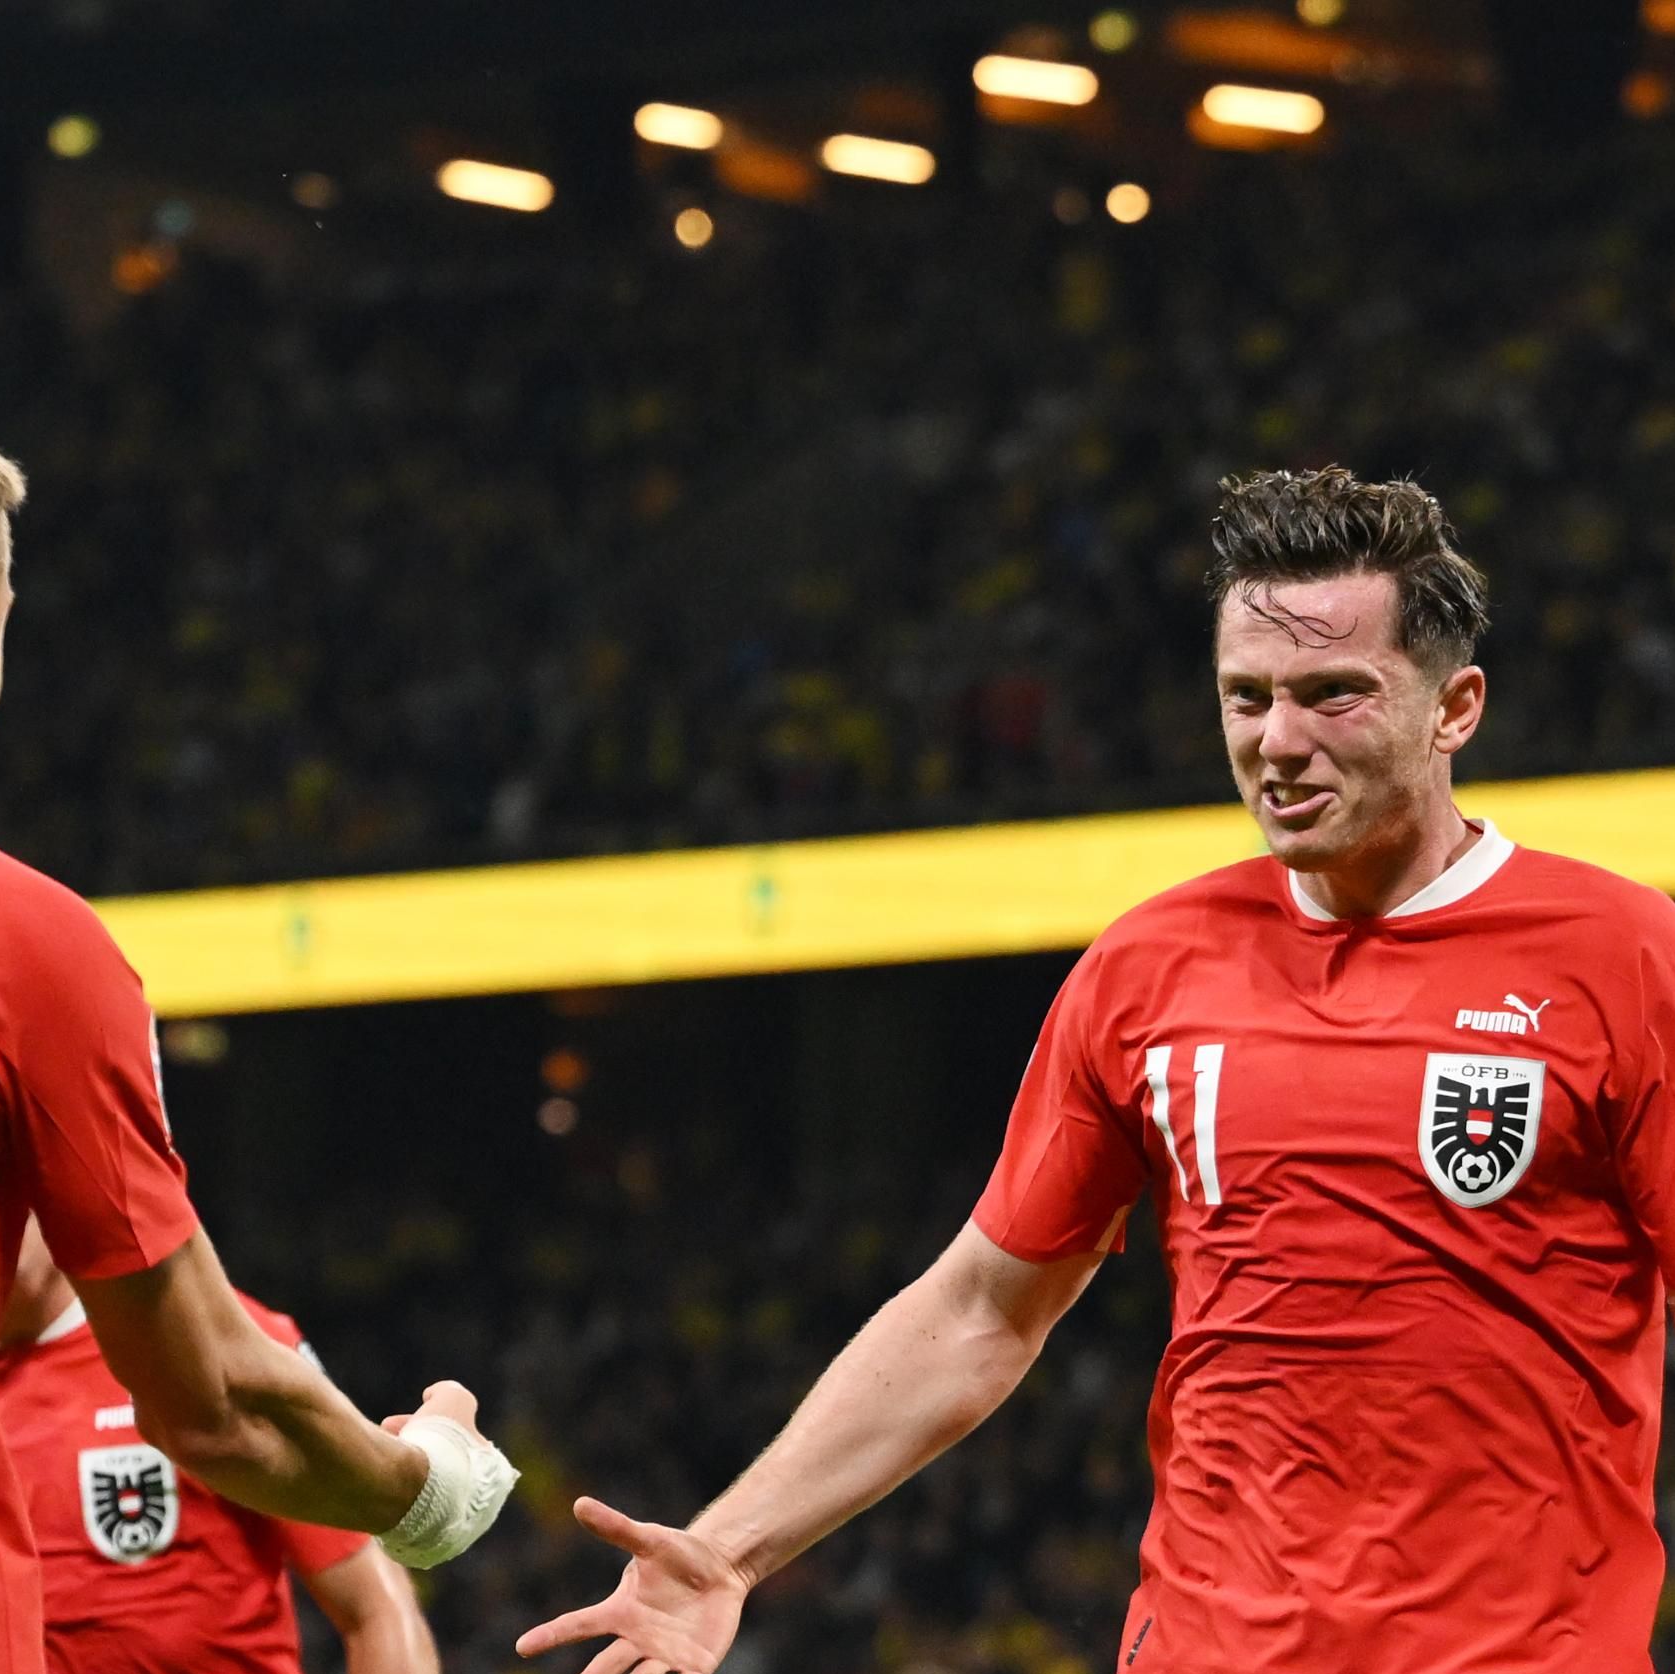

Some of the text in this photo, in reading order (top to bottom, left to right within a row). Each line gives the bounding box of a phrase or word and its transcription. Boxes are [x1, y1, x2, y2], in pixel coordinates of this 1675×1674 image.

[1455, 1009, 1527, 1035] PUMA
[1461, 1062, 1510, 1079] ÖFB
[1145, 1044, 1225, 1205] 11
